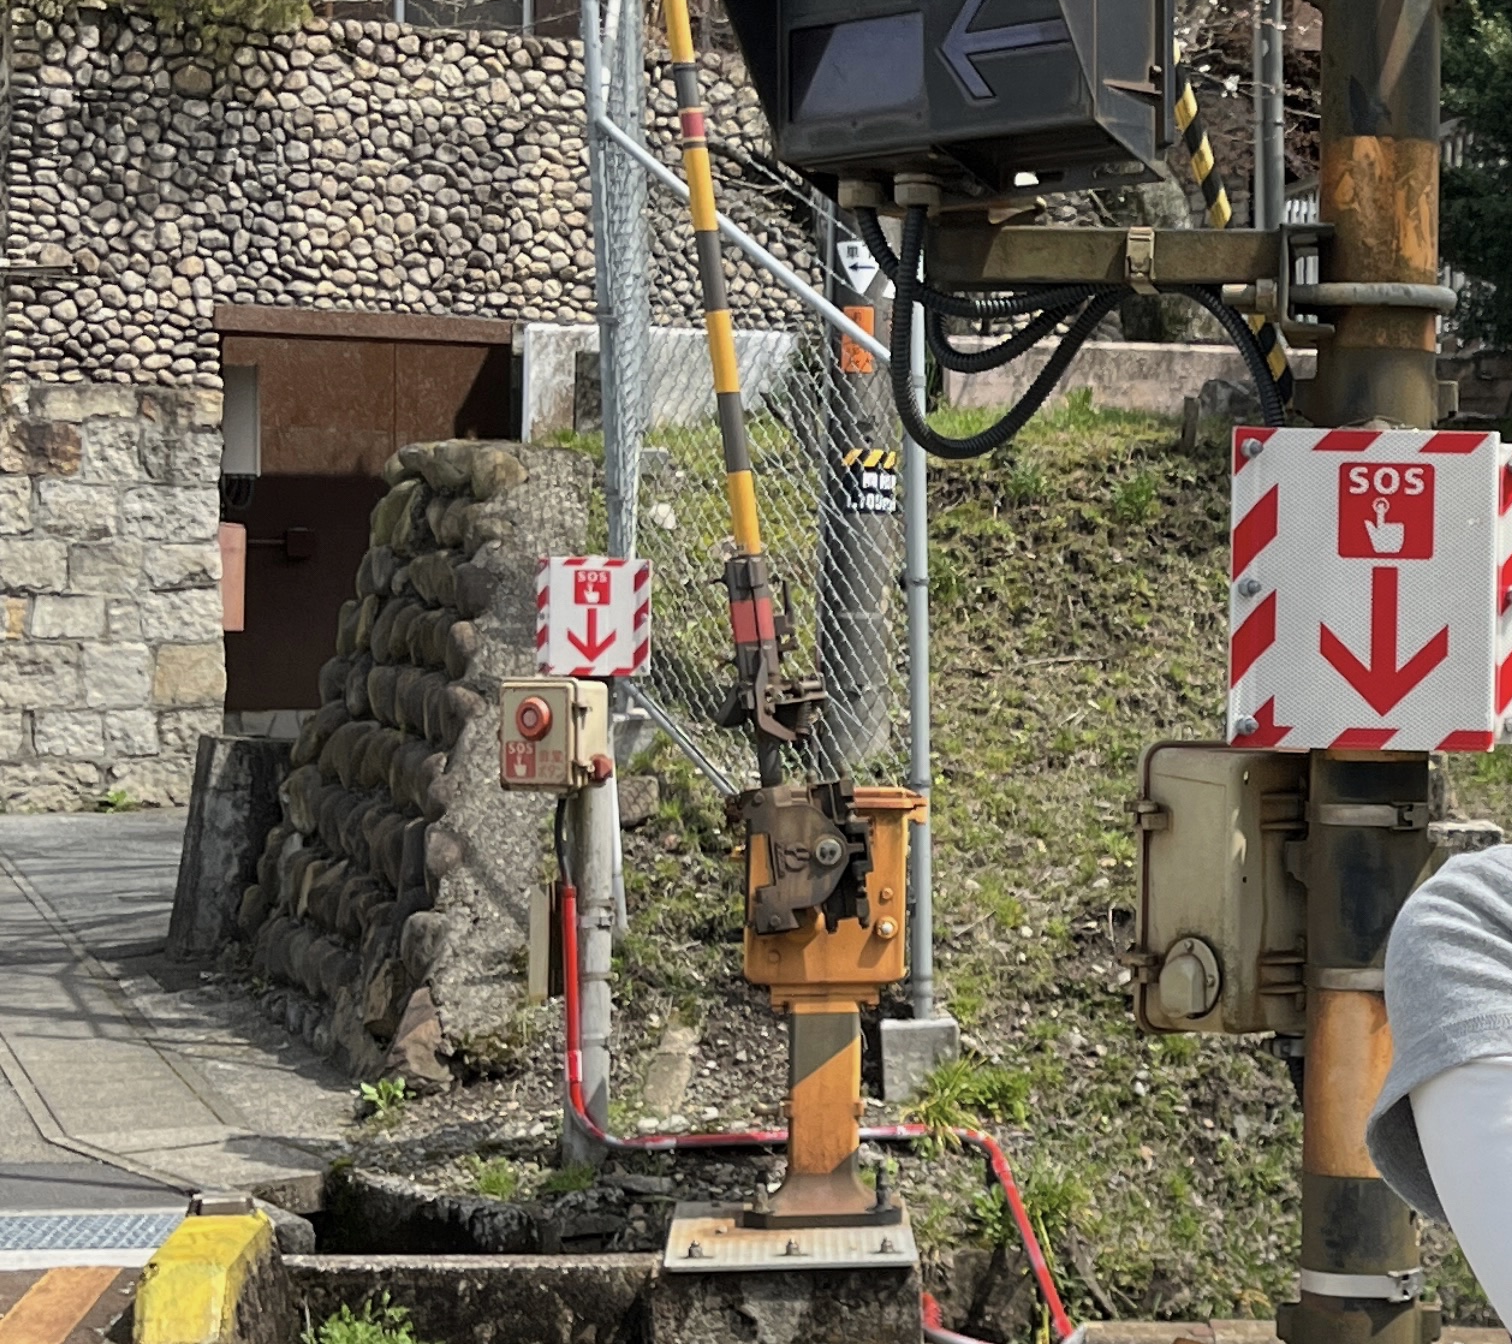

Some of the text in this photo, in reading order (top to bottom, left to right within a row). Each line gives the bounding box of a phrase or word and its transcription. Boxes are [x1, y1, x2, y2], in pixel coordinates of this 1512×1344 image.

[1349, 466, 1425, 495] SOS
[577, 570, 607, 583] SOS
[508, 742, 534, 755] SOS
